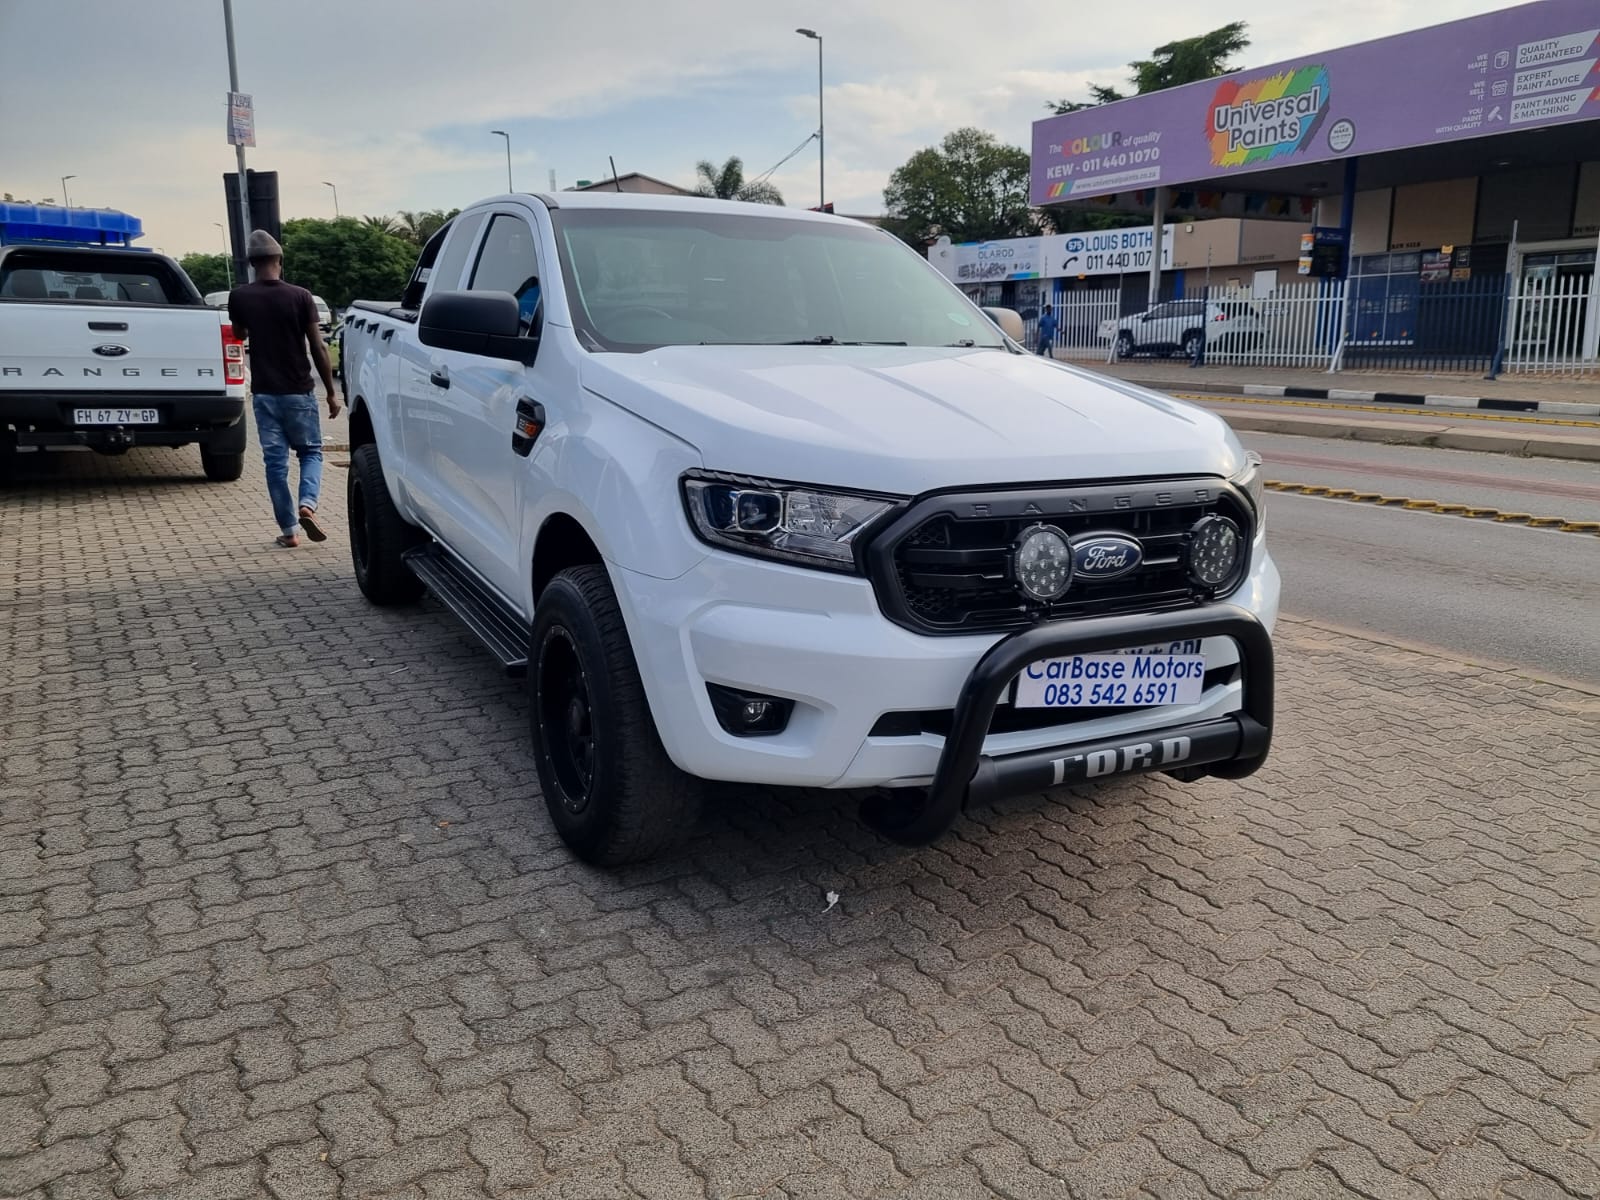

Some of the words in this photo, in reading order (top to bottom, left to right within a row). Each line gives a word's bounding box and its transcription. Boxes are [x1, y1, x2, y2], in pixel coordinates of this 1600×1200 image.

[1519, 45, 1583, 64] GUARANTEED
[1520, 41, 1560, 55] QUALITY
[1516, 81, 1543, 92] PAINT
[1545, 74, 1580, 87] ADVICE
[1517, 70, 1552, 83] EXPERT
[1215, 88, 1319, 131] Universal
[1514, 100, 1541, 110] PAINT
[1543, 94, 1577, 106] MIXING
[1521, 105, 1569, 118] MATCHING
[1230, 118, 1299, 150] Paints
[1453, 121, 1482, 132] QUALITY
[1048, 144, 1062, 154] The
[1063, 131, 1122, 157] COLOUR
[1122, 136, 1133, 147] of
[1133, 131, 1162, 146] quality
[1047, 163, 1074, 179] KEW
[1082, 158, 1100, 172] 011
[1103, 153, 1126, 168] 440
[1129, 147, 1160, 164] 1070
[1086, 235, 1119, 252] LOUIS
[1121, 231, 1153, 249] BOTH
[1086, 254, 1104, 270] 011
[1107, 252, 1130, 268] 440
[2, 367, 215, 377] RANGER
[77, 411, 92, 422] FH
[98, 411, 111, 422] 67
[118, 411, 131, 422] ZY
[142, 411, 156, 422] GP
[970, 489, 1210, 517] RANGER
[1084, 545, 1128, 571] Ford
[1026, 656, 1125, 680] CarBase
[1131, 656, 1203, 679] Motors
[1044, 684, 1082, 705] 083
[1089, 683, 1127, 704] 542
[1132, 683, 1178, 703] 6591
